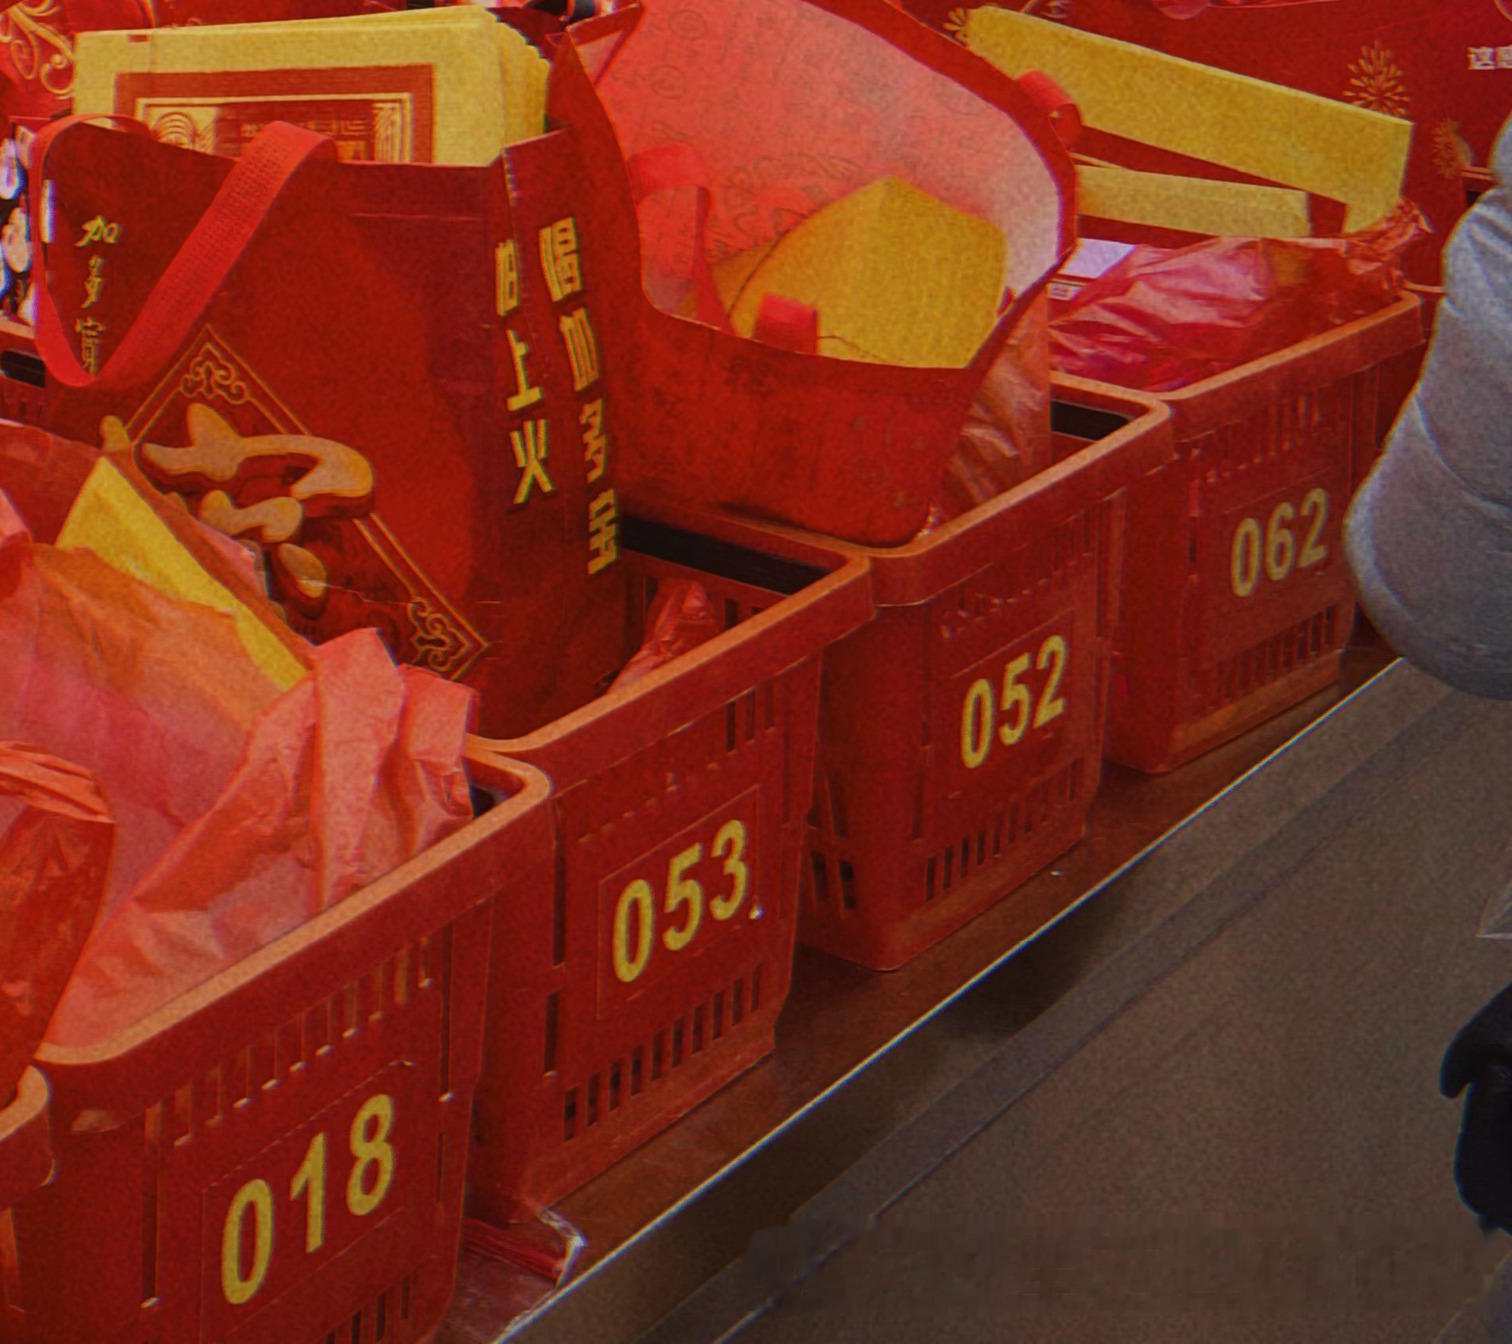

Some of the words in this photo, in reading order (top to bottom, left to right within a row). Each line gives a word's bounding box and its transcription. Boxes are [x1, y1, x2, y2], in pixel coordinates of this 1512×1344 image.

[494, 239, 555, 506] 怕上火
[539, 216, 620, 575] 喝加多宝
[1230, 485, 1331, 601] 062
[959, 634, 1068, 770] 052
[611, 818, 751, 985] 053
[221, 1092, 396, 1307] 018
